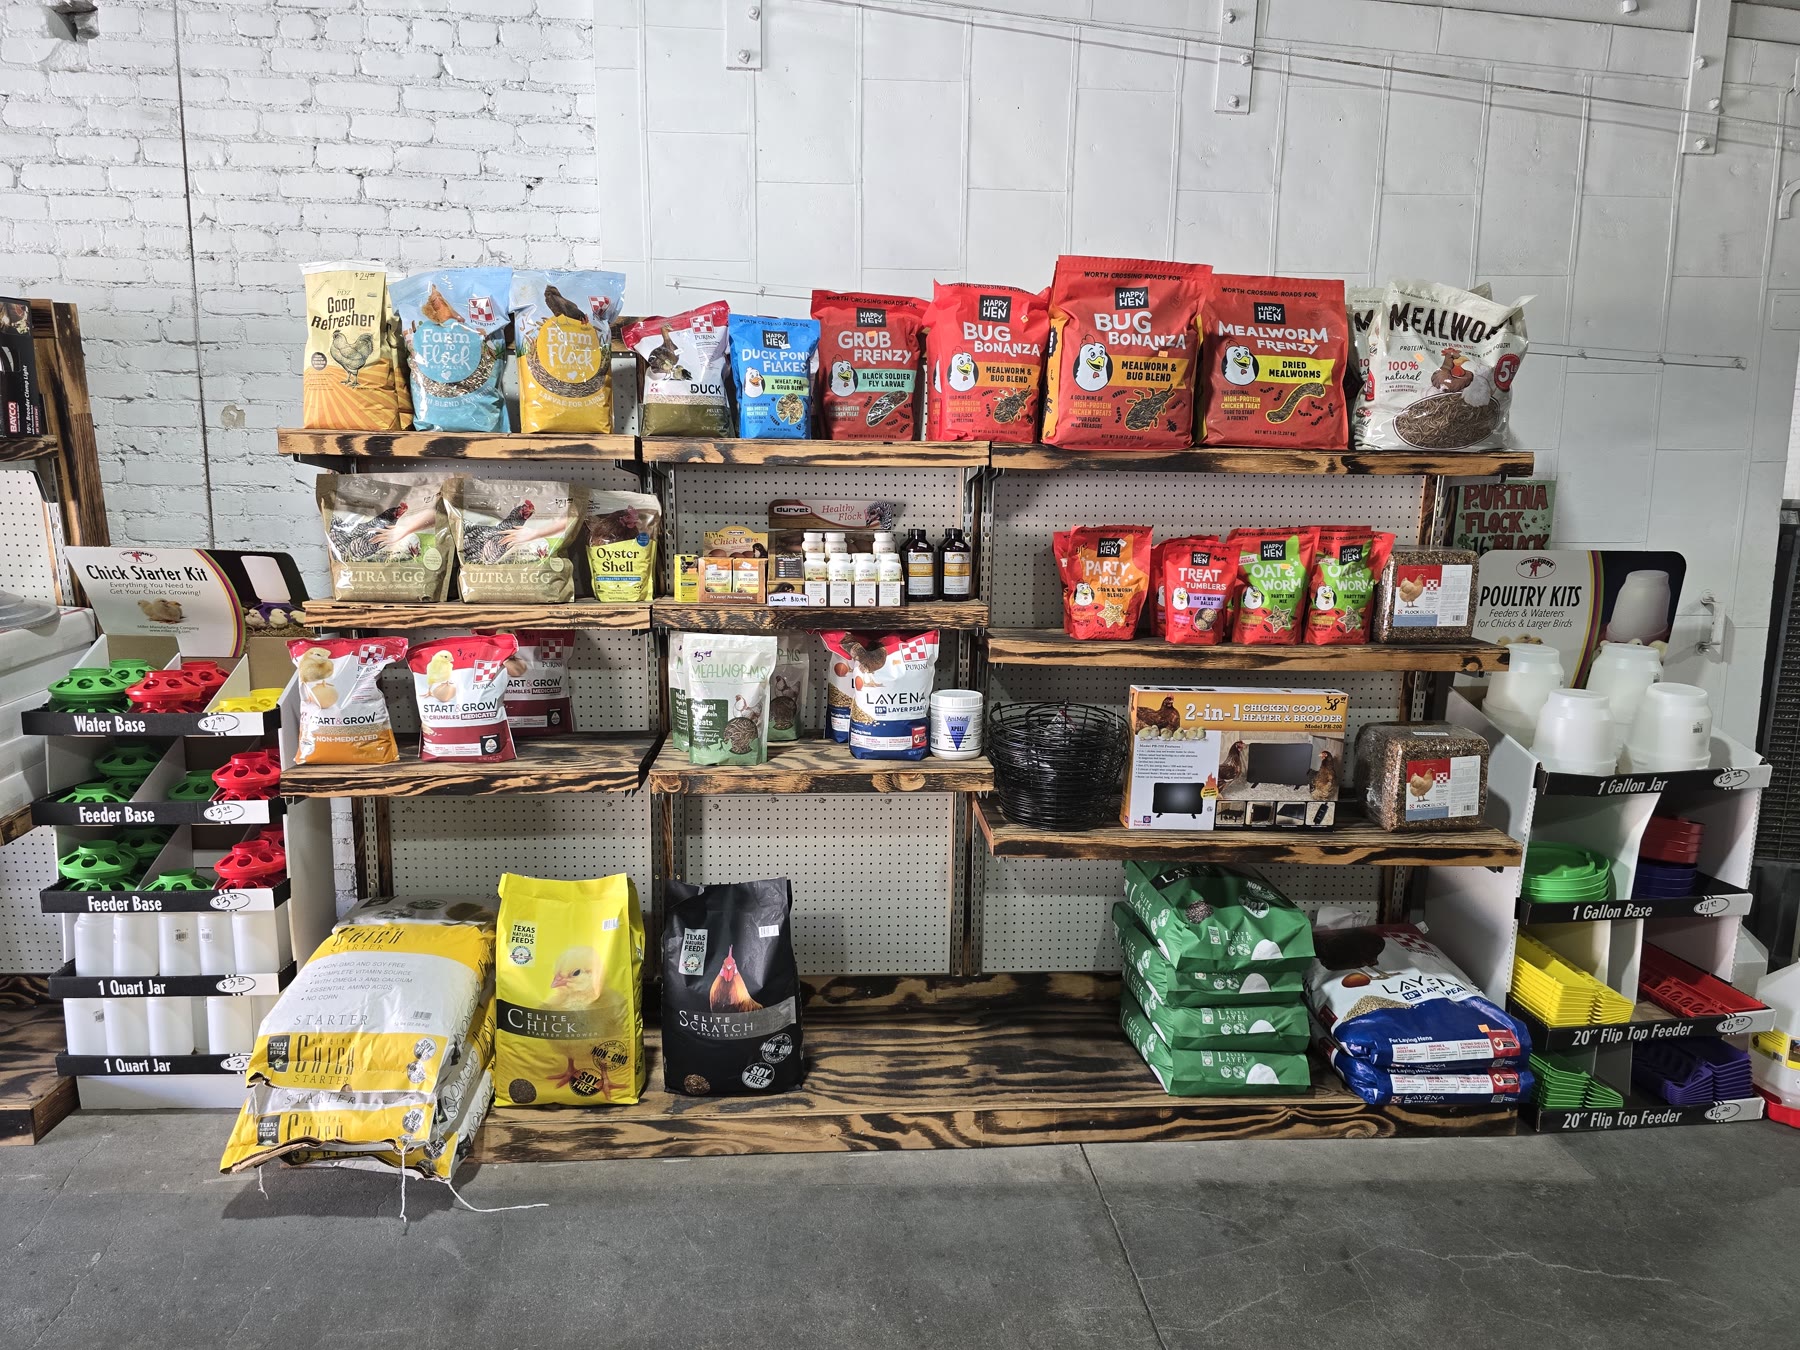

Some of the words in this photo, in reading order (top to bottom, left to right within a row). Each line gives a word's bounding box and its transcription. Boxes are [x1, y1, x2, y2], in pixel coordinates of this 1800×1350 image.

[1119, 291, 1145, 299] HAPPY
[1246, 289, 1278, 297] CROSSING
[328, 297, 355, 313] Coop
[983, 299, 1007, 309] HAPPY
[1119, 297, 1144, 307] HEN
[983, 307, 1007, 319] HEN
[1258, 311, 1281, 321] HEN
[311, 310, 375, 331] Refresher
[860, 316, 882, 324] HEN
[1094, 312, 1152, 333] BUG
[422, 329, 470, 343] Farm
[547, 327, 592, 345] Farm
[963, 322, 1010, 342] BUG
[1218, 321, 1328, 343] MEALWORM
[838, 330, 891, 349] GRUB
[1108, 331, 1186, 350] BONANZA
[974, 342, 1041, 357] BONANZA
[1257, 340, 1319, 355] FRENZY
[421, 344, 471, 370] Flock
[547, 343, 594, 371] Flock
[742, 349, 777, 361] DUCK
[854, 349, 911, 364] FRENZY
[763, 360, 807, 373] FLAKES
[986, 366, 1025, 375] MEALWORM
[1121, 361, 1169, 371] MEALWORM
[1170, 363, 1177, 372] &
[1282, 361, 1307, 369] DRIED
[1388, 361, 1419, 371] 100%
[1006, 375, 1028, 383] BLEND
[1127, 371, 1143, 381] BUG
[1145, 372, 1171, 382] BLEND
[1268, 369, 1321, 379] MEALWORMS
[1385, 371, 1421, 381] natural
[690, 384, 721, 394] DUCK
[1464, 484, 1548, 510] PURINA
[822, 504, 855, 513] Healthy
[838, 512, 862, 520] Flock
[1465, 512, 1524, 534] FLOCK
[597, 547, 639, 561] Oyster
[1100, 546, 1118, 554] HEN
[1264, 549, 1283, 558] HEN
[86, 565, 132, 580] Chick
[132, 565, 181, 581] Starter
[185, 567, 208, 581] Kit
[602, 561, 633, 572] Shell
[1085, 561, 1130, 577] PARTY
[1251, 563, 1281, 578] OAT
[1285, 563, 1296, 577] &
[469, 572, 515, 583] ULTRA
[520, 572, 550, 584] EGG
[1100, 576, 1120, 586] MIX
[1178, 568, 1222, 582] TREAT
[1186, 582, 1226, 591] TUMBLERS
[1261, 577, 1301, 592] WORM
[1480, 586, 1546, 607] POULTRY
[1550, 586, 1582, 607] KITS
[1489, 609, 1520, 617] Feeders
[1530, 609, 1564, 618] Waterers
[1477, 619, 1489, 627] for
[1491, 619, 1516, 628] Chicks
[1526, 619, 1551, 629] Larger
[1553, 619, 1572, 628] Birds
[866, 693, 926, 705] LAYENA
[1185, 703, 1240, 721] 2-in-1
[1243, 704, 1289, 712] CHICKEN
[1292, 705, 1322, 713] COOP
[462, 712, 496, 720] MEDICATED
[1242, 714, 1281, 722] HEATER
[1293, 714, 1342, 722] BROODER
[74, 716, 111, 732] Water
[116, 717, 146, 732] Base
[316, 734, 378, 742] NON-MEDICATED
[1598, 780, 1604, 795] 1
[1608, 778, 1644, 794] Gallon
[1647, 777, 1668, 791] Jar
[79, 806, 121, 823] Feeder
[125, 807, 155, 823] Base
[88, 895, 129, 911] Feeder
[132, 897, 162, 911] Base
[1572, 906, 1578, 920] 1
[1583, 904, 1621, 919] Gallon
[1624, 903, 1652, 917] Base
[513, 924, 536, 934] TEXAS
[686, 933, 706, 941] TEXAS
[685, 944, 705, 952] FEEDS
[98, 981, 105, 995] 1
[110, 981, 144, 995] Quart
[148, 981, 166, 995] Jar
[294, 1015, 368, 1026] STARTER
[507, 1008, 576, 1033] CHICK
[527, 1012, 567, 1021] ELITE
[679, 1010, 754, 1033] SCRATCH
[694, 1015, 730, 1023] ELITE
[1572, 1030, 1597, 1045] 20"
[1600, 1029, 1623, 1044] Flip
[1626, 1027, 1648, 1042] Top
[1650, 1023, 1693, 1038] Feeder
[760, 1041, 793, 1055] NON-GMO
[591, 1046, 627, 1065] NON-GMO
[104, 1059, 111, 1072] 1
[116, 1058, 149, 1072] Quart
[153, 1059, 171, 1072] Jar
[750, 1065, 771, 1077] SOY
[293, 1075, 348, 1084] STARTER
[578, 1071, 599, 1084] SOY
[746, 1074, 767, 1087] FREE
[573, 1081, 594, 1095] FREE
[1562, 1112, 1587, 1128] 20"
[1590, 1112, 1613, 1128] Flip
[1616, 1112, 1637, 1127] Top
[1639, 1111, 1682, 1125] Feeder
